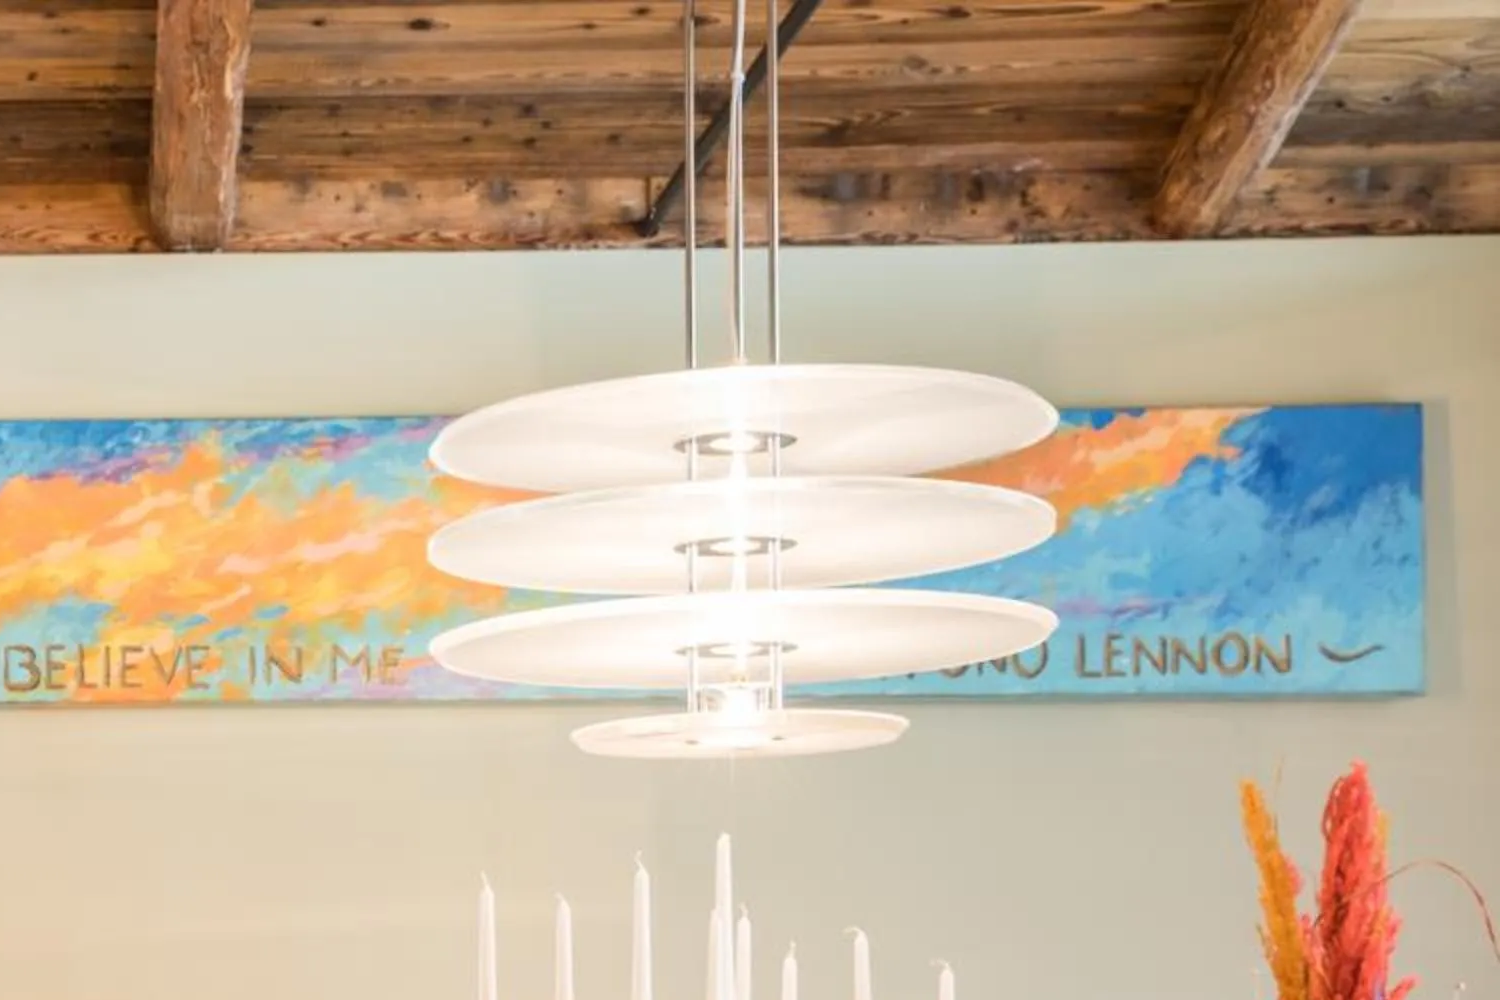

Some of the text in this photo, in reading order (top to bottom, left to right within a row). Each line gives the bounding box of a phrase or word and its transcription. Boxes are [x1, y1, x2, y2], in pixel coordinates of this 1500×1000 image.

[3, 645, 211, 692] BELIEVE
[248, 644, 303, 685] IN
[331, 644, 404, 685] ME
[1076, 632, 1293, 678] LENNON
